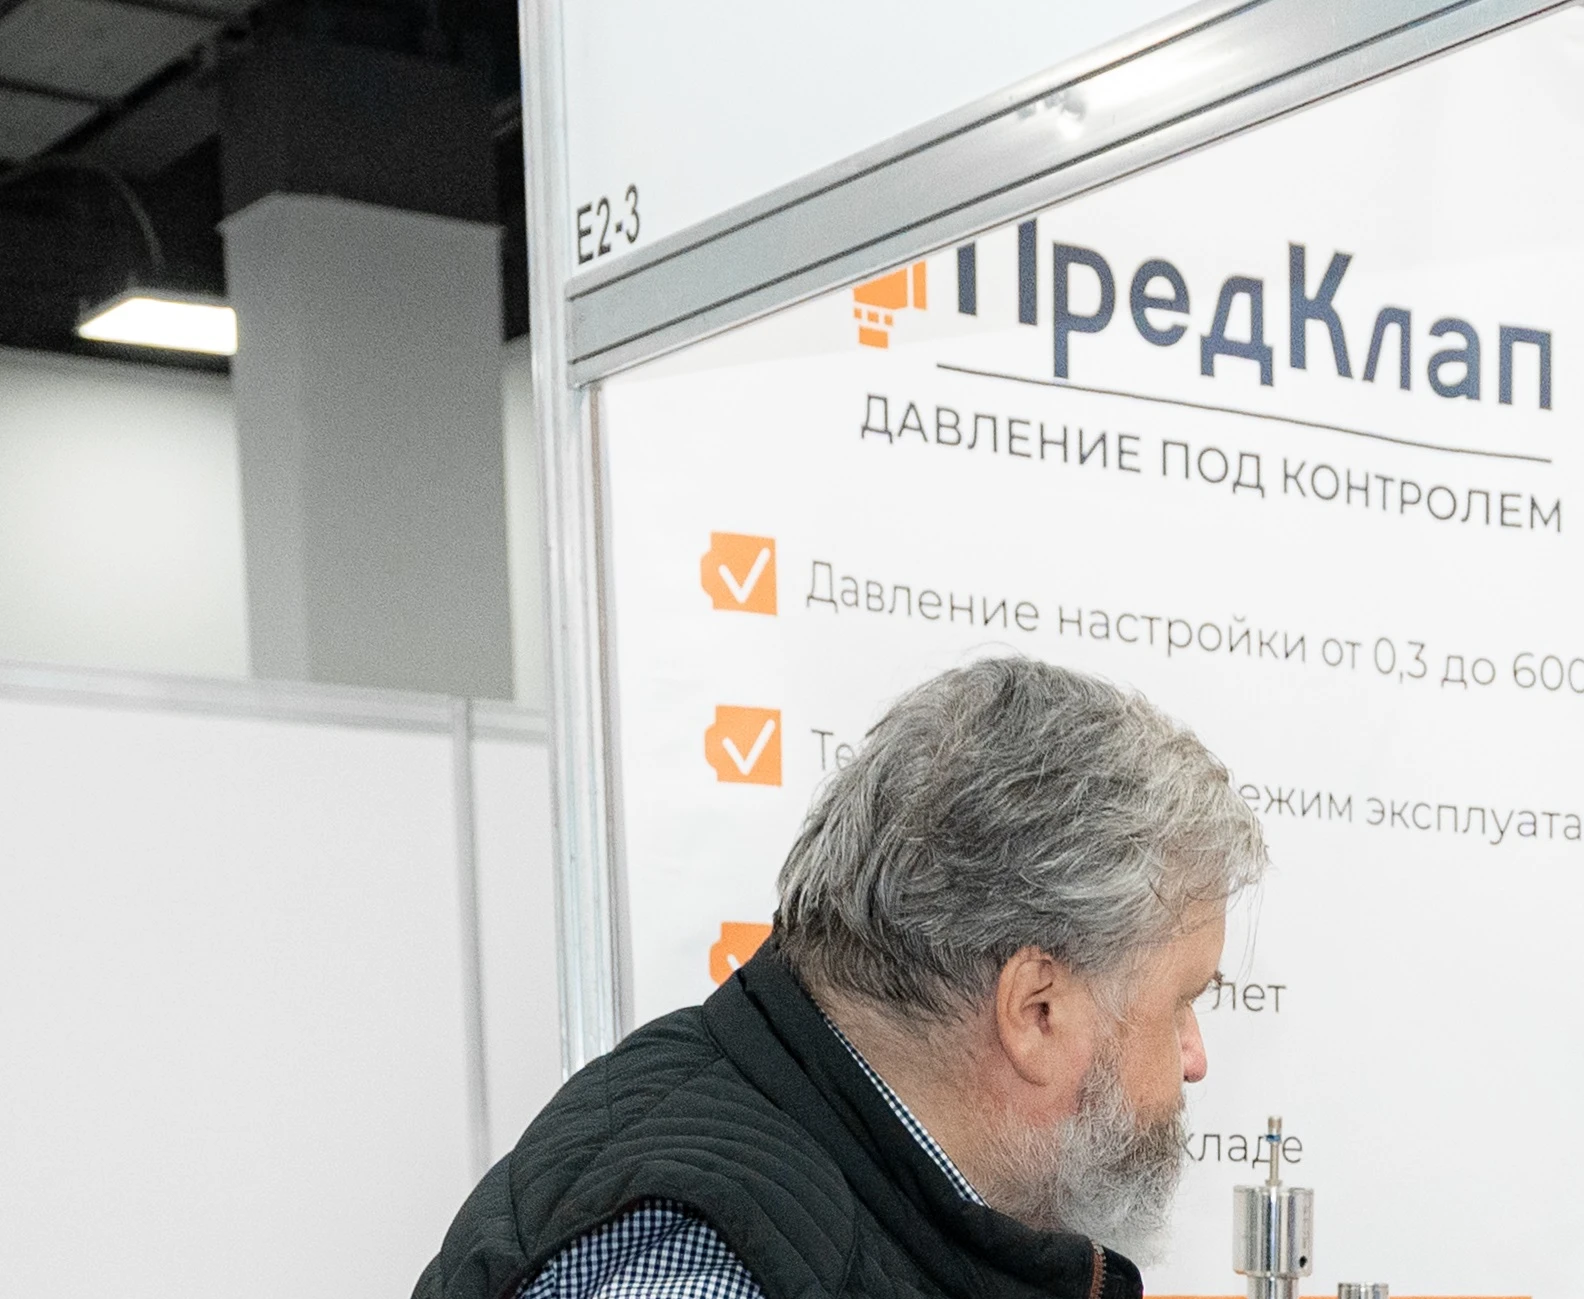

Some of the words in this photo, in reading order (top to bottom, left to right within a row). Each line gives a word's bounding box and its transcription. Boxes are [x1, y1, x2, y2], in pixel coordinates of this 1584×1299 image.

[576, 184, 641, 266] E2-3
[956, 217, 1553, 411] ПредКлап
[860, 393, 1142, 474] ДАВЛЕНИЕ
[1161, 439, 1266, 499] ПОД
[1282, 457, 1562, 533] КОНТРОЛЕМ
[805, 559, 1040, 633] Давление
[1058, 605, 1306, 662] настройки
[1321, 637, 1362, 670] от
[1373, 636, 1428, 683] 0,3
[1440, 654, 1497, 690] до
[1239, 784, 1353, 822] ежим
[1212, 982, 1287, 1012] лет
